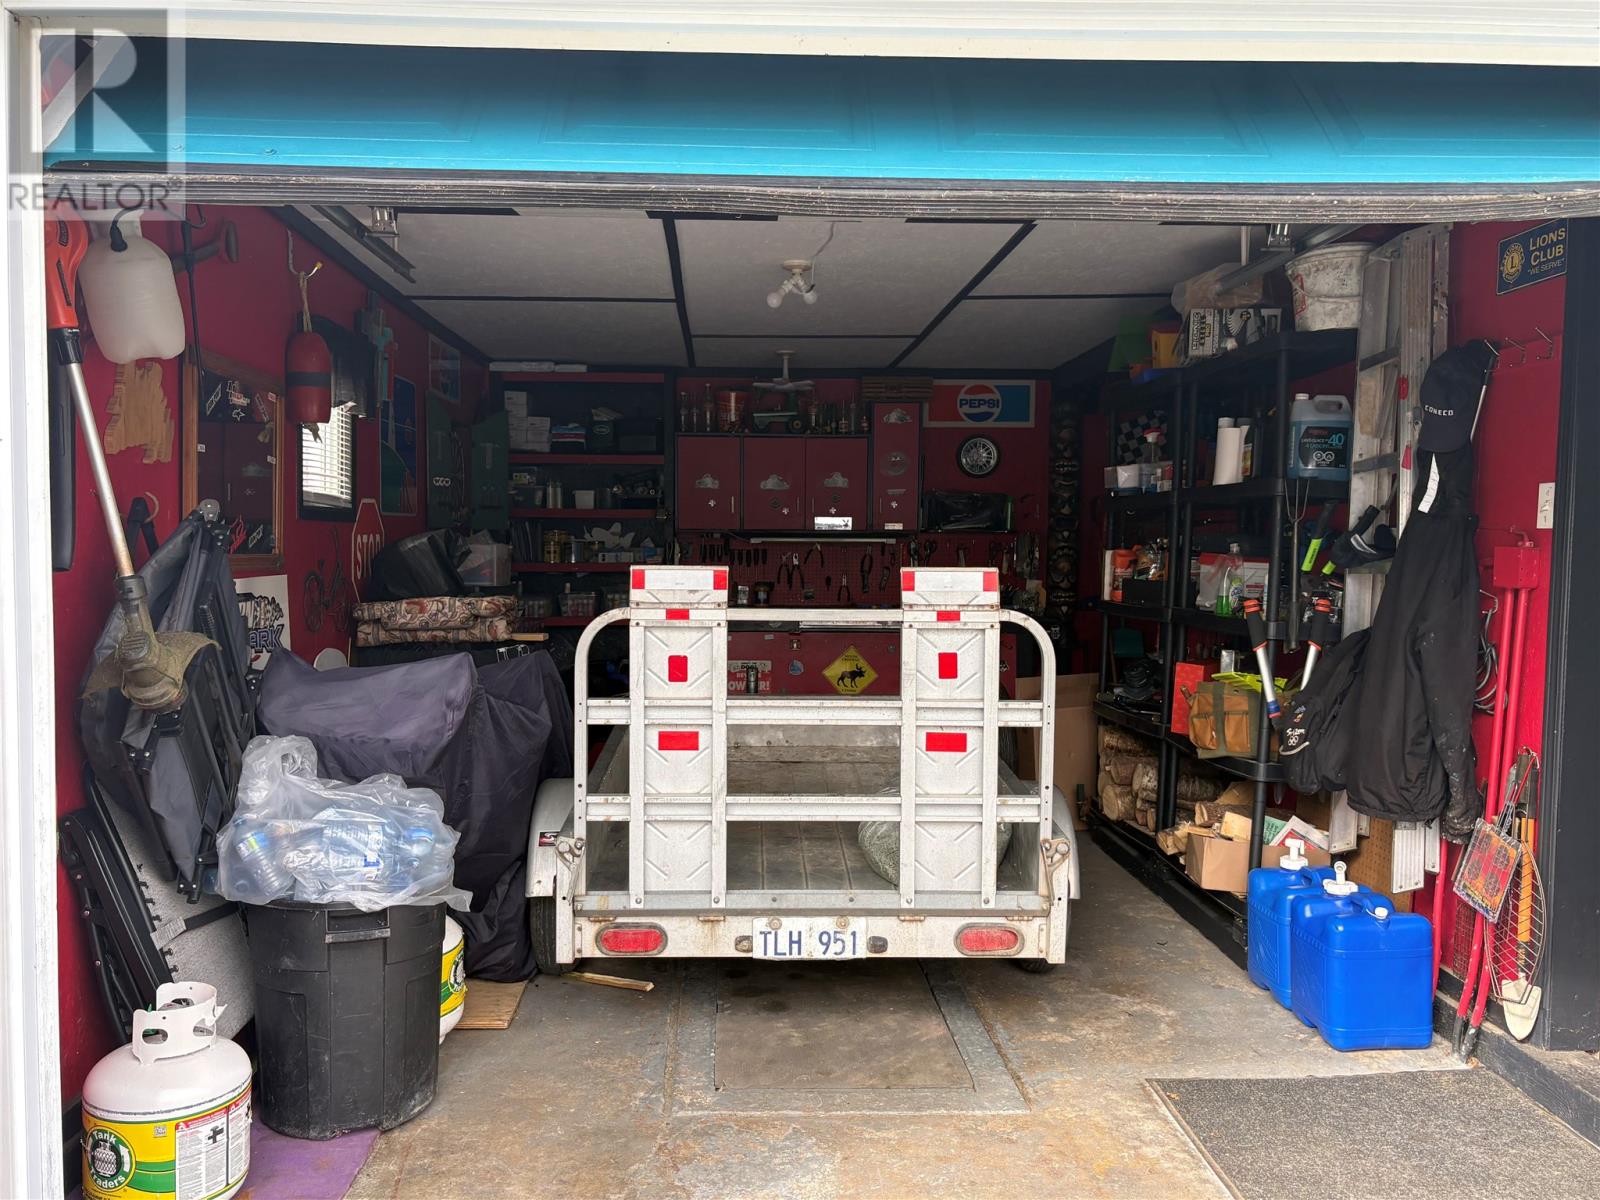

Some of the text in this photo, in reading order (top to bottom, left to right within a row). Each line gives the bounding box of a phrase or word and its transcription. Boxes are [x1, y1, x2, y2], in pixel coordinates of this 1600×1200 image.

[1529, 228, 1566, 251] LIONS
[1530, 244, 1564, 266] CLUB
[959, 398, 1000, 409] PEPSI
[728, 680, 770, 691] OWR!
[759, 930, 857, 956] TLH 951
[93, 1129, 117, 1145] Tank
[89, 1166, 126, 1189] Traders
